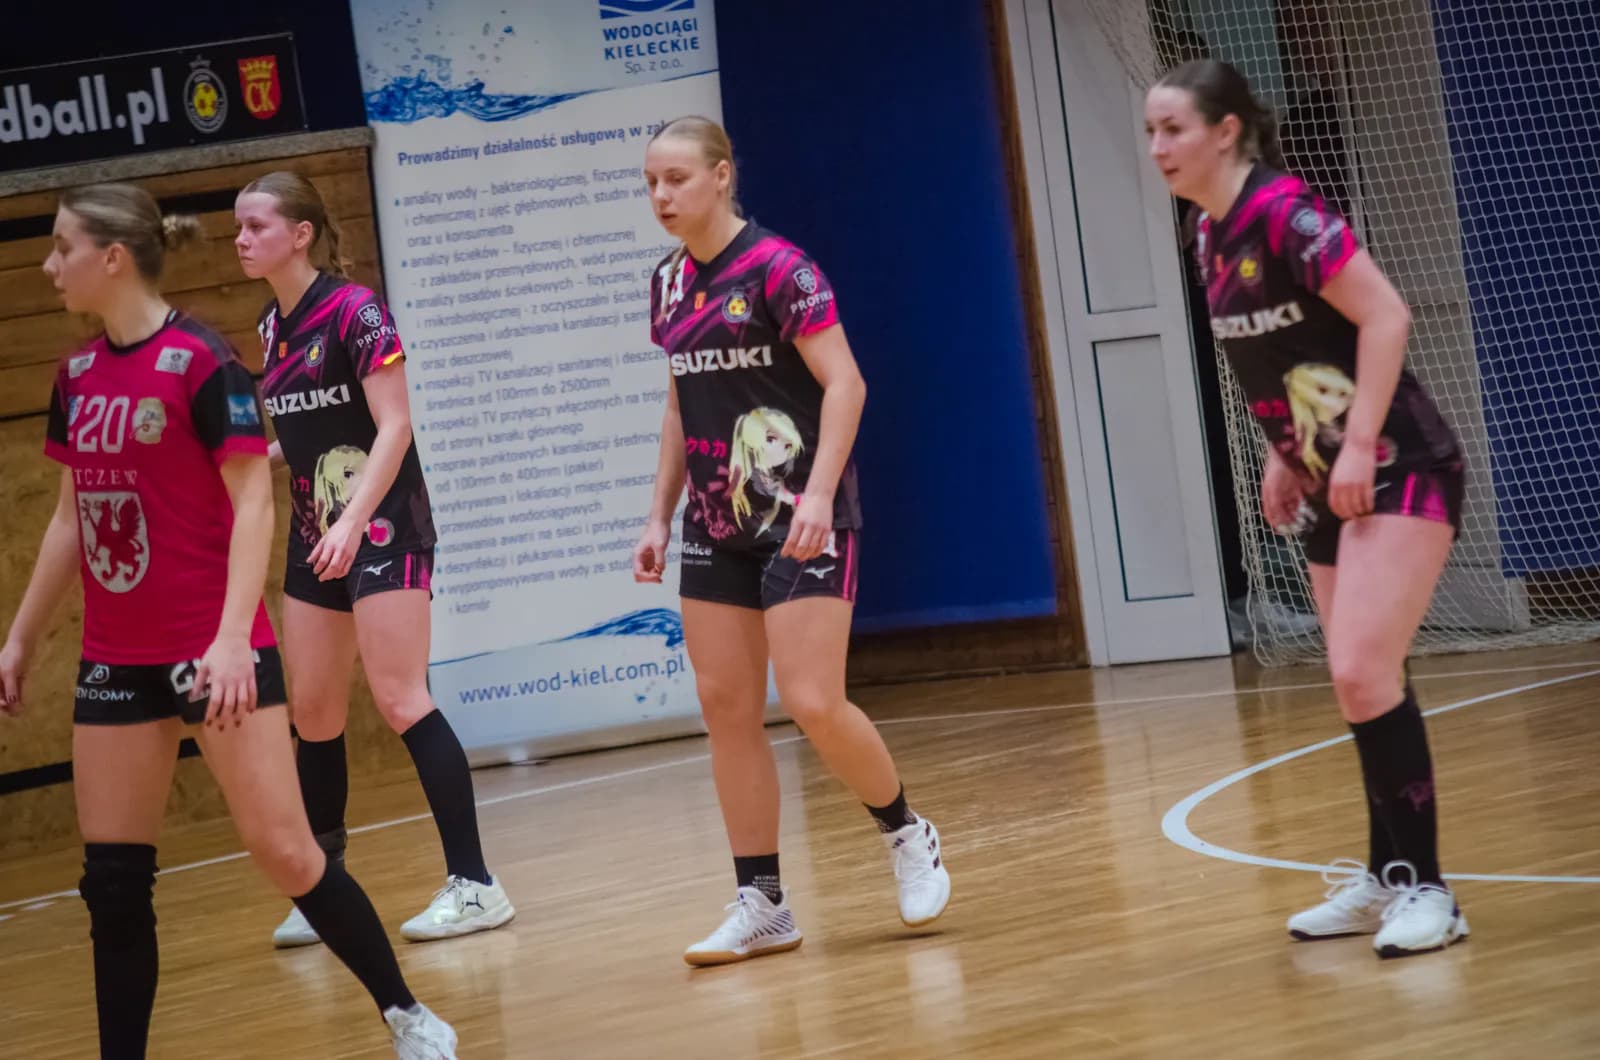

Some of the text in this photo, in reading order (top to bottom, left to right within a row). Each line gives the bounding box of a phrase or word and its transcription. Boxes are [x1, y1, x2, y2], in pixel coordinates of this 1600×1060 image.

[603, 18, 698, 41] WODOCIĄGI
[604, 37, 700, 60] KIELECKIE
[624, 59, 684, 74] Sp. z o.o.
[398, 145, 479, 166] Prowadzimy
[483, 133, 557, 155] działalność
[561, 128, 626, 146] usługową
[446, 185, 477, 201] wody
[408, 234, 432, 248] oraz
[445, 224, 514, 242] konsumenta
[453, 245, 499, 263] ścieków
[572, 229, 636, 247] chemicznej
[430, 269, 482, 286] zakładów
[580, 251, 606, 266] wód
[458, 286, 502, 303] osadów
[505, 276, 574, 297] ściekowych
[421, 349, 513, 371] oraz deszczowej
[671, 345, 773, 377] SUZUKI
[477, 369, 493, 383] TV
[264, 383, 352, 418] SUZUKI
[478, 391, 493, 404] od
[496, 386, 538, 401] 100mm
[541, 382, 557, 396] do
[560, 376, 611, 393] 2500mm
[481, 409, 497, 424] TV
[626, 393, 640, 404] na
[76, 394, 131, 454] 20
[430, 437, 446, 452] od
[449, 436, 484, 450] strony
[527, 422, 584, 442] głównego
[74, 467, 138, 486] TCZEW
[433, 457, 477, 472] napraw
[435, 479, 451, 492] od
[454, 475, 496, 489] 100mm
[499, 471, 514, 484] do
[517, 466, 561, 480] 400mm
[537, 528, 553, 540] na
[558, 564, 590, 579] wody
[459, 654, 685, 704] www.wod-kiel.com.pl
